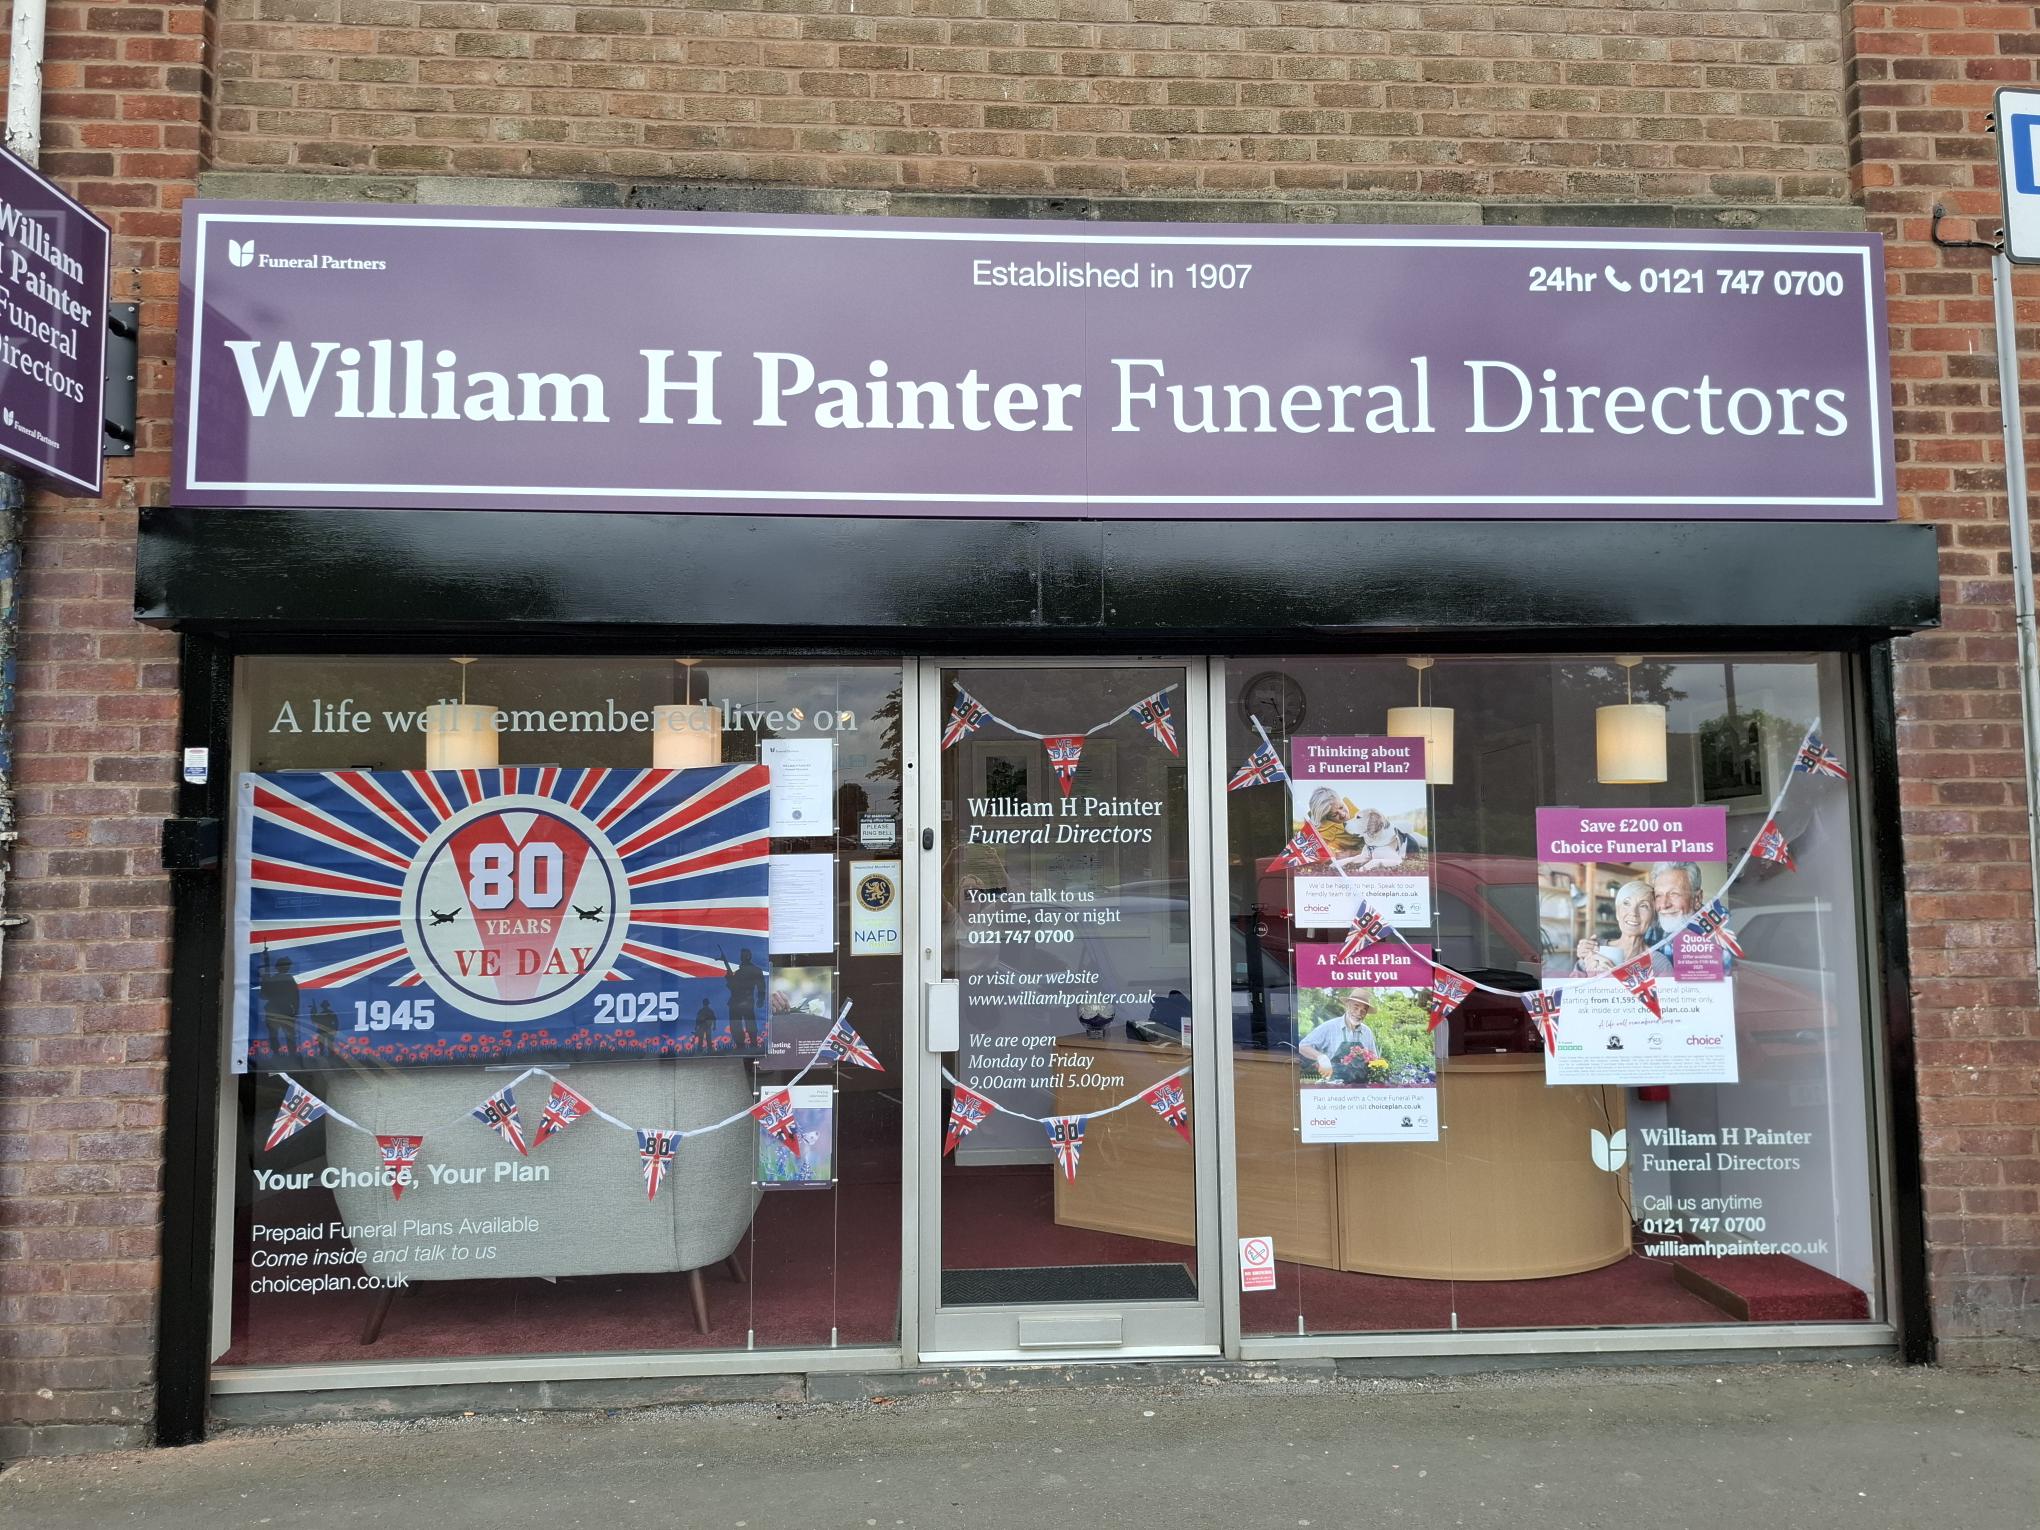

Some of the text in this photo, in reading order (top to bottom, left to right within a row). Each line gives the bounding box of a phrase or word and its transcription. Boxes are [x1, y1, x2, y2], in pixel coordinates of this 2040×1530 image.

[0, 200, 84, 285] William
[258, 253, 386, 271] Funeral Partners
[973, 258, 1253, 289] Established in 1907
[1529, 266, 1843, 296] 24hr 0121 747 0700
[10, 249, 92, 328] Painter
[0, 334, 84, 404] irectors
[224, 338, 1849, 437] William H Painter Funeral Directors
[14, 420, 60, 449] Funeral Partners
[270, 698, 858, 733] A life well remembered lives on
[957, 701, 982, 726] 80
[1140, 700, 1166, 724] 80
[1307, 745, 1410, 760] Thinking about
[1801, 743, 1822, 768] 80
[1255, 751, 1277, 778] 80
[1308, 761, 1410, 773] a Funeral Plan?
[968, 797, 1163, 817] William H Painter
[967, 823, 1152, 844] Funeral Directors
[1580, 818, 1683, 833] Save £200 on
[1551, 839, 1714, 854] Choice Funeral Plans
[468, 840, 564, 911] 80
[968, 888, 1095, 904] You can talk to us
[1366, 890, 1418, 898] choiceplan.co.uk
[968, 908, 1121, 927] anytime, day or night
[1304, 904, 1329, 912] choice
[485, 917, 552, 937] YEARS
[1357, 911, 1383, 936] 80
[1699, 909, 1722, 934] 80
[854, 929, 898, 942] NAFD
[968, 929, 1074, 944] 0121 747 0700
[1680, 943, 1715, 953] 200OFF
[454, 946, 592, 979] VE DAY
[1317, 954, 1327, 965] A
[1382, 953, 1411, 965] Plan
[968, 970, 1099, 985] or visit our website
[1331, 969, 1398, 983] to suit you
[968, 989, 1156, 1008] www.williamhpainter.co.uk
[1575, 986, 1586, 994] For
[593, 991, 679, 1025] 2025
[1532, 995, 1556, 1015] 80
[1562, 996, 1588, 1005] starting
[1611, 996, 1636, 1004] £1,595
[1592, 1006, 1614, 1014] inside
[1623, 1006, 1636, 1014] visit
[1638, 1005, 1700, 1015] choplan.co.uk
[353, 998, 435, 1033] 1945
[829, 1029, 855, 1057] 80
[969, 1033, 1056, 1050] We are open
[1686, 1034, 1721, 1046] choice
[968, 1052, 1094, 1070] Monday to Friday
[969, 1073, 1124, 1090] 9.00am until 5.00pm
[287, 1094, 314, 1121] 80
[484, 1098, 512, 1124] 80
[1368, 1103, 1421, 1111] choiceplan.co.uk
[1310, 1117, 1336, 1126] choice
[1053, 1123, 1079, 1141] 80
[1640, 1127, 1812, 1146] William H Painter
[645, 1137, 671, 1156] 80
[1642, 1152, 1800, 1172] Funeral Directors
[254, 1160, 550, 1193] Your Choice, Your Plan
[1643, 1195, 1763, 1213] Call us anytime
[252, 1215, 540, 1246] Prepaid Funeral Plans Available
[1643, 1217, 1767, 1234] 0121 747 0700
[251, 1243, 497, 1268] Come inside and talk to us
[1644, 1239, 1829, 1258] williamhpainter.co.uk
[250, 1269, 409, 1295] choiceplan.co.uk
